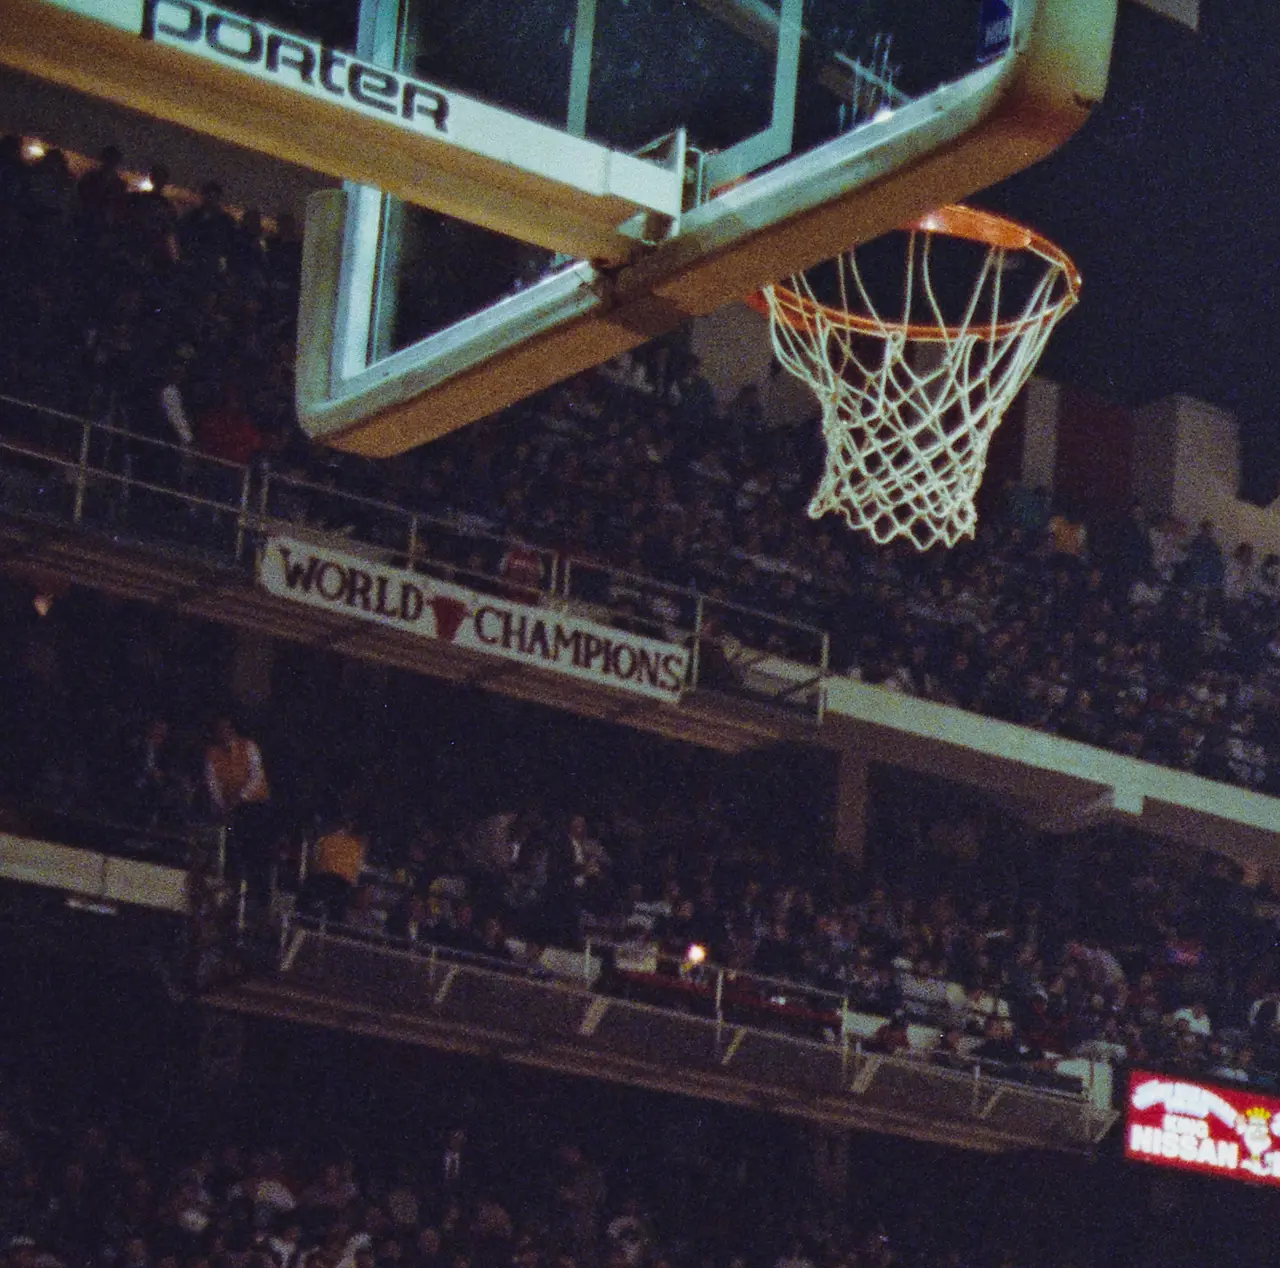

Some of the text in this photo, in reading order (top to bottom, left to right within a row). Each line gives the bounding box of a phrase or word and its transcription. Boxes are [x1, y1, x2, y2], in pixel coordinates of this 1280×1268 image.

[279, 546, 683, 695] WORLD CHAMPIONS
[1130, 1124, 1239, 1169] NISSAN
